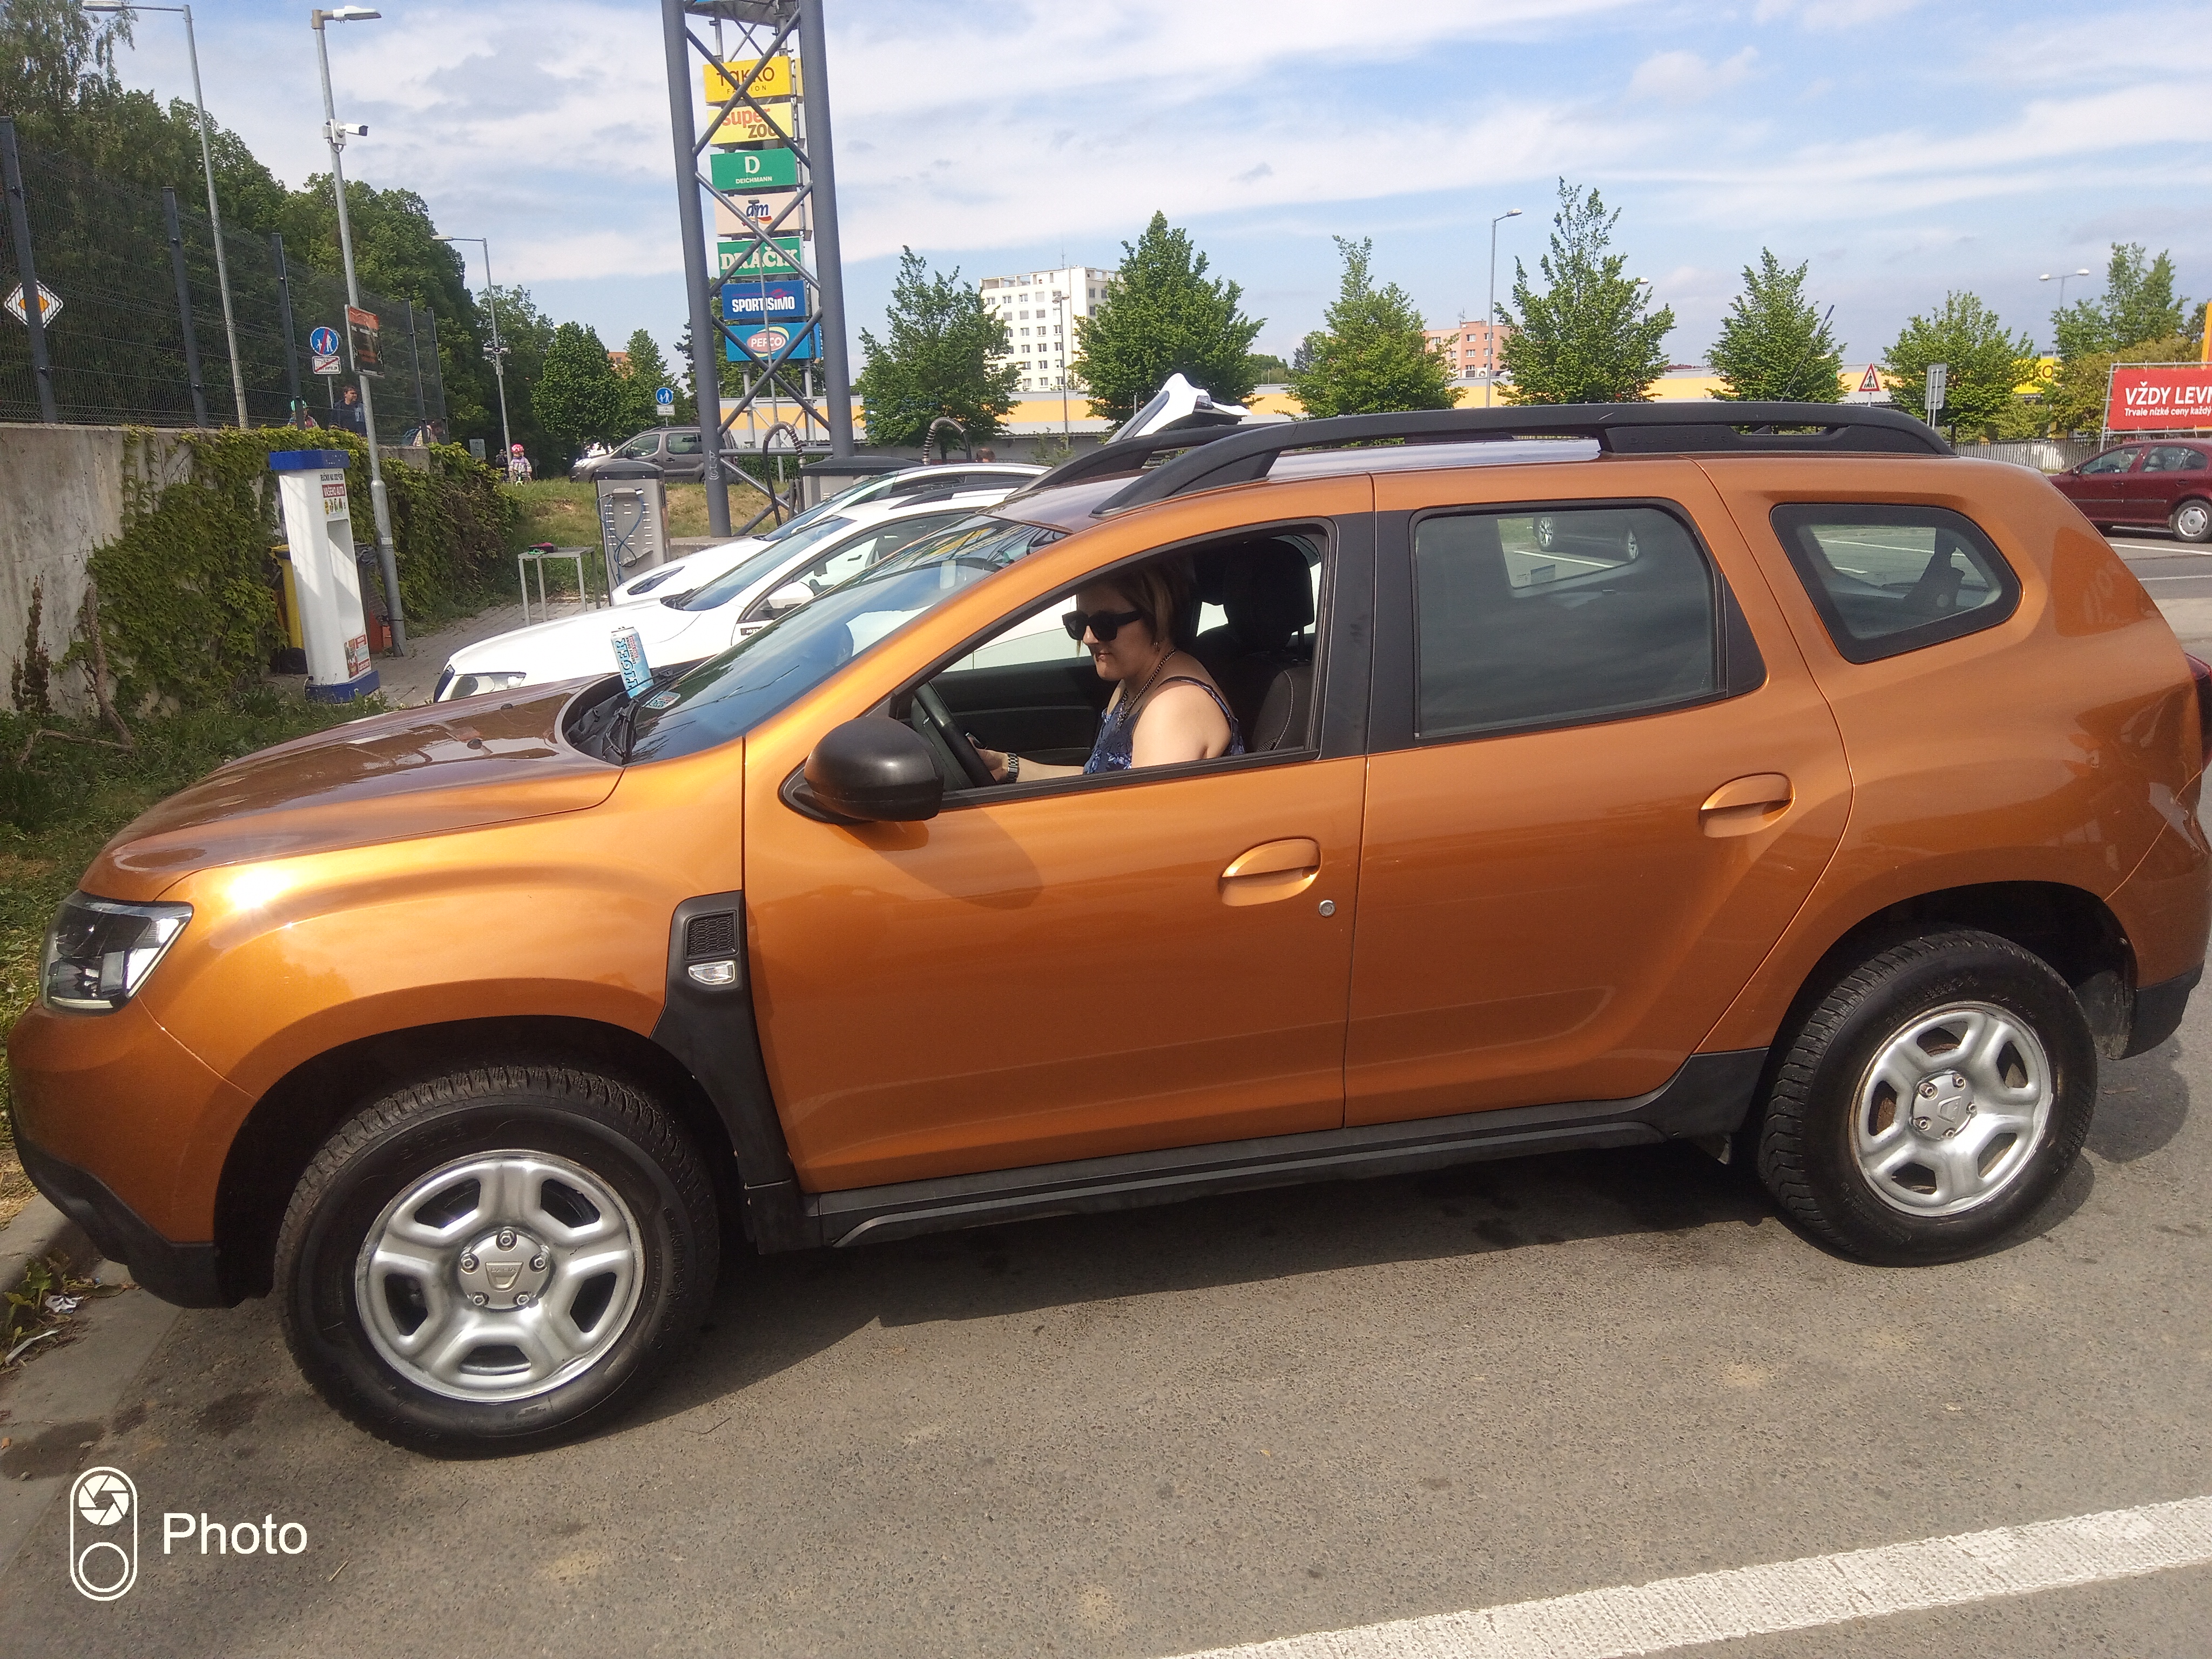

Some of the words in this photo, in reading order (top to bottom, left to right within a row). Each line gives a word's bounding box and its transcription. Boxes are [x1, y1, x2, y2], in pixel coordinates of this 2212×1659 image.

[727, 85, 767, 95] FAION
[745, 156, 760, 174] D
[735, 176, 773, 184] DEICHMANN
[2125, 381, 2171, 405] VŽDY
[2125, 408, 2148, 416] Trvale
[2149, 407, 2169, 416] nízké
[2170, 408, 2190, 417] ceny
[615, 638, 639, 688] TIGER
